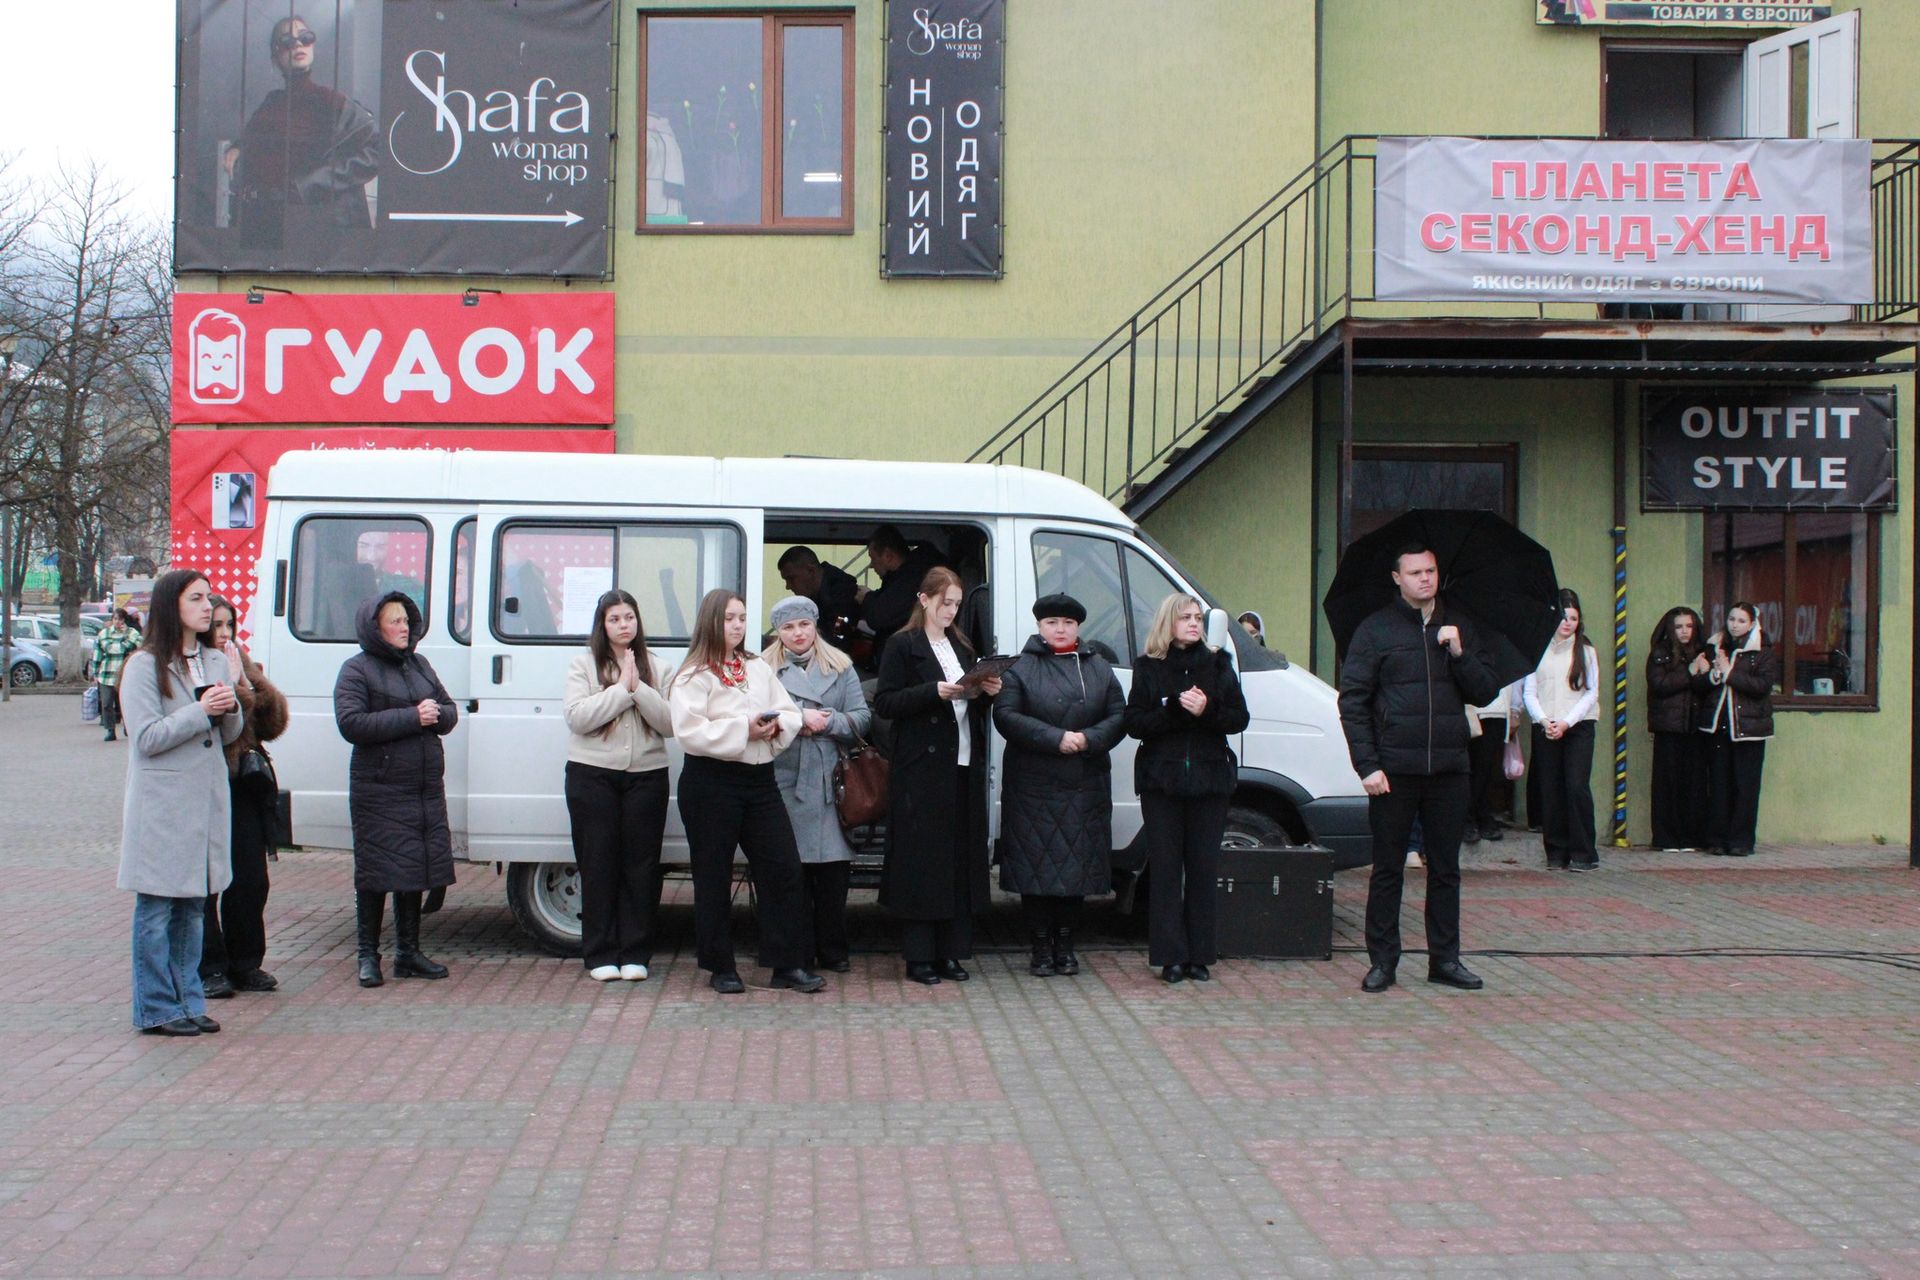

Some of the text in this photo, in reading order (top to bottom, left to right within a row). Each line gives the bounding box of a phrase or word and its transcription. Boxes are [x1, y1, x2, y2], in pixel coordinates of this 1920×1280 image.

[1650, 5, 1718, 21] ТОВАРИ
[1741, 6, 1814, 21] ЄВРОПИ
[906, 7, 983, 56] Shafa
[945, 42, 982, 52] woman
[956, 50, 982, 61] shop
[389, 49, 590, 175] Shafa
[491, 141, 589, 160] woman
[906, 78, 933, 255] НОВИЙ
[522, 159, 588, 186] shop
[955, 100, 982, 240] ОДЯГ
[1490, 160, 1763, 202] ПЛАНЕТА
[1419, 211, 1832, 263] СЕКОНД-ХЕНД
[1471, 272, 1574, 291] ЯКІСНИЙ
[1580, 275, 1644, 293] ОДЯГ
[1669, 275, 1765, 292] ЄВРОПИ
[264, 326, 596, 404] ГУДОК
[1680, 405, 1861, 440] OUTFIT
[1692, 455, 1848, 490] STYLE
